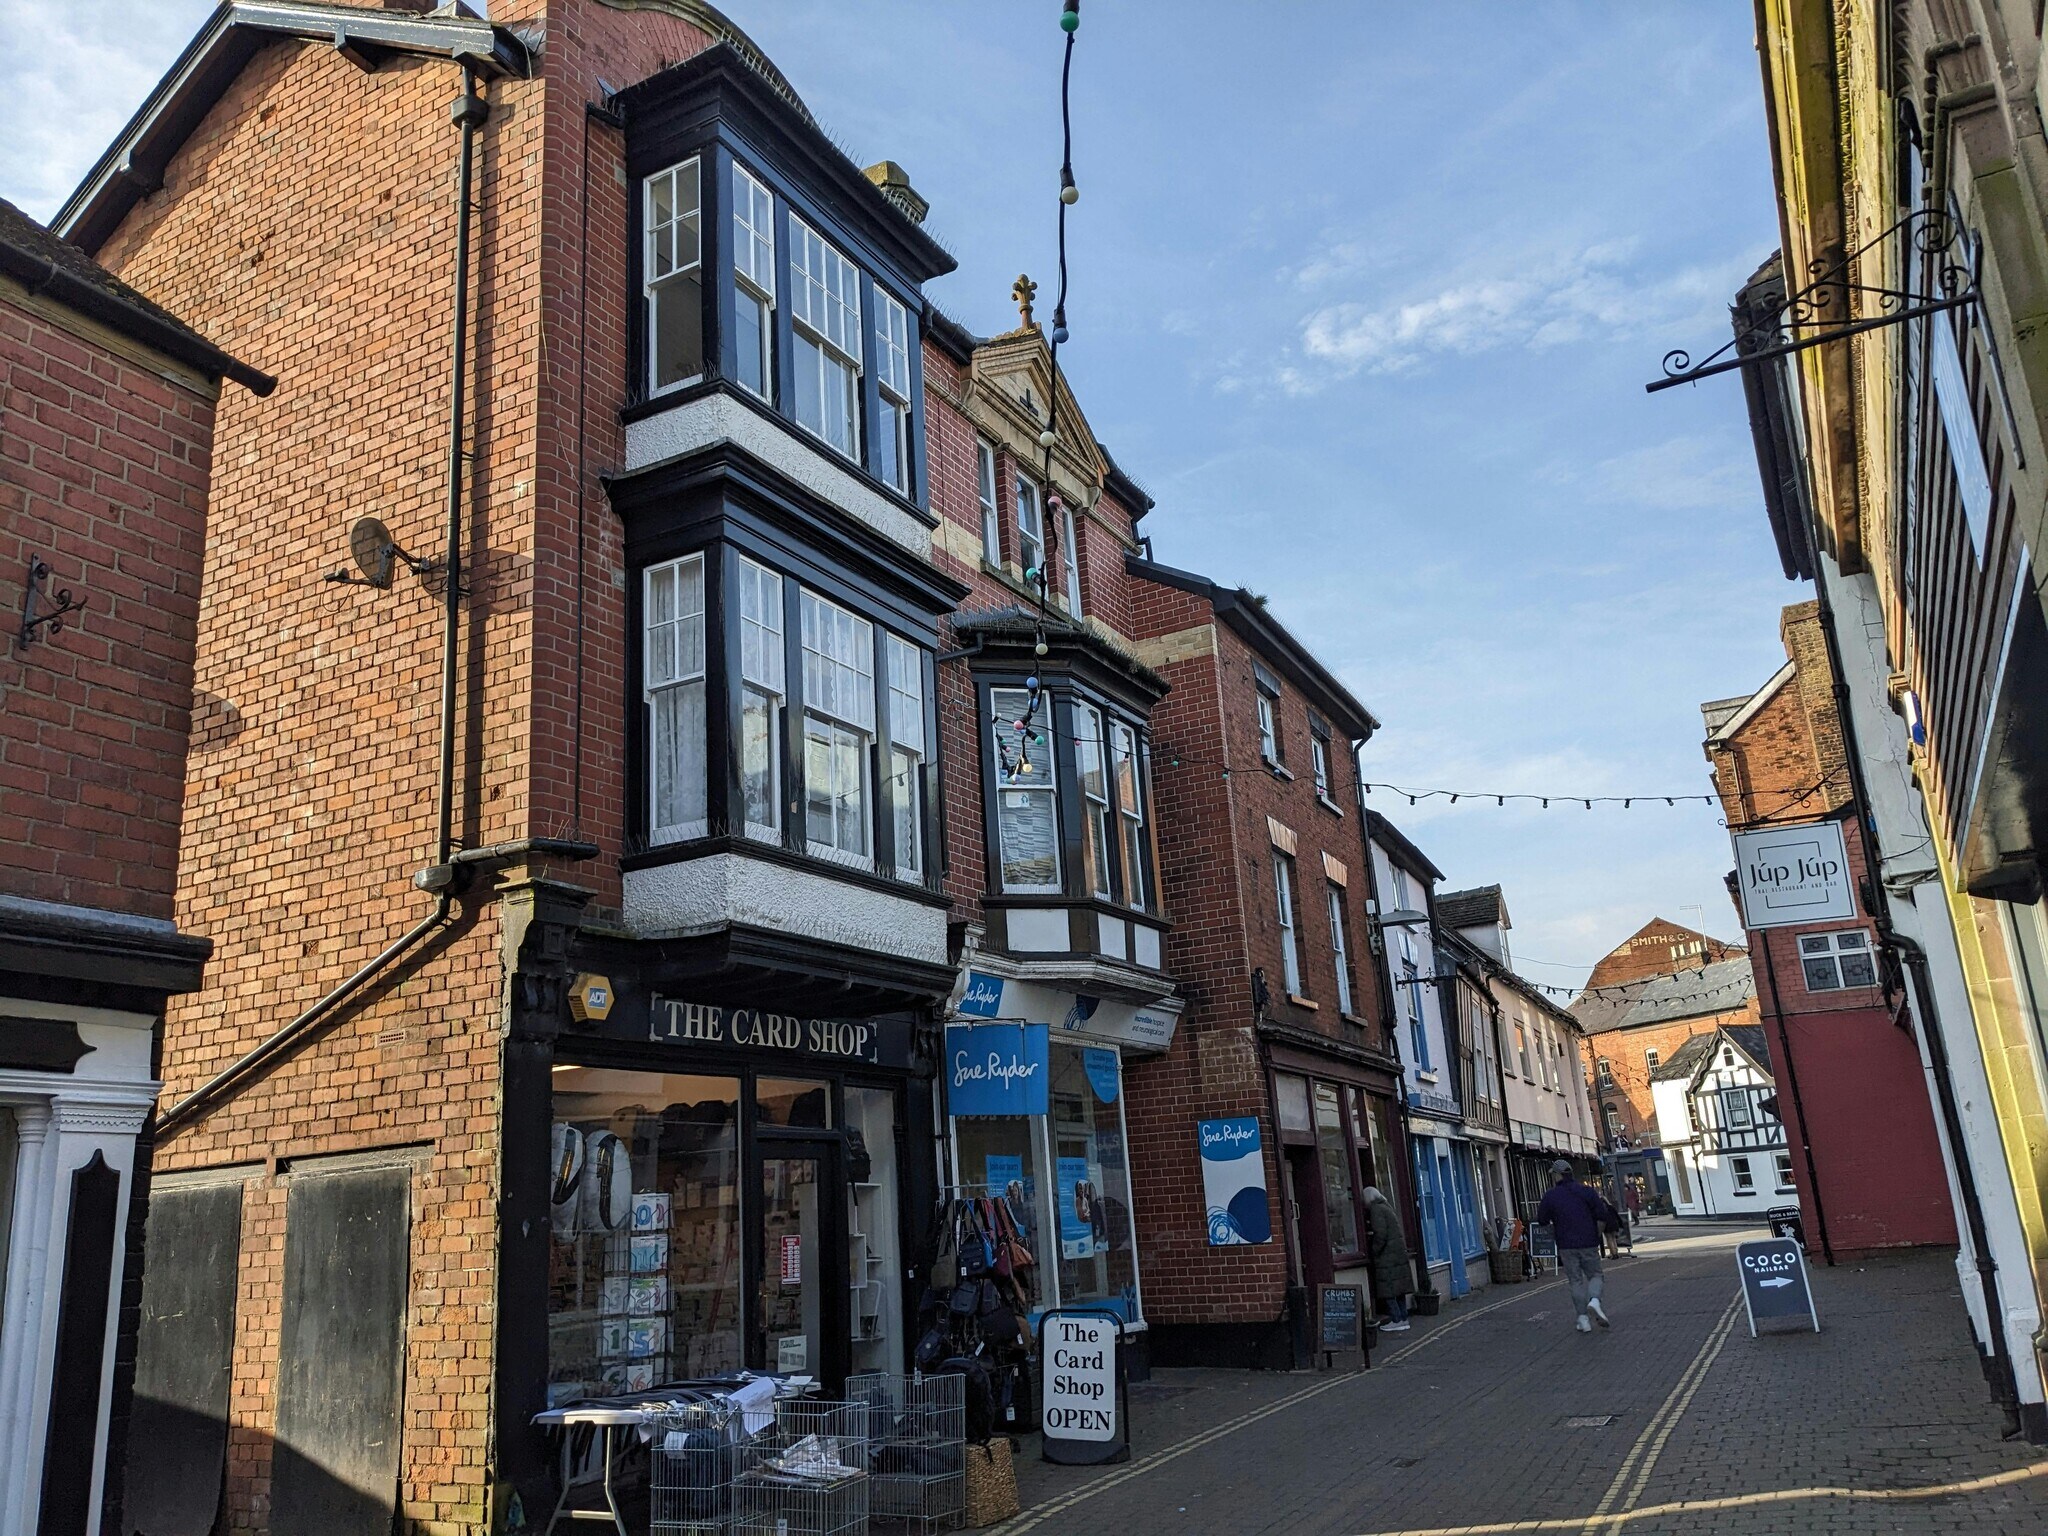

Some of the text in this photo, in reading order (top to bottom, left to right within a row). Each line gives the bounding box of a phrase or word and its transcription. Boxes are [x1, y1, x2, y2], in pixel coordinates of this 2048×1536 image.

[1750, 857, 1838, 889] Júp Júp
[1772, 884, 1807, 893] RESTAURANT
[1632, 935, 1667, 946] SMITH
[1668, 934, 1676, 943] &
[588, 991, 607, 1004] ADT
[974, 982, 999, 1012] Ryder
[664, 998, 868, 1056] THE CARD SHOP
[954, 1050, 1039, 1090] Sue Ryder
[1202, 1124, 1256, 1147] Sue Ryder
[1744, 1252, 1796, 1268] COCO
[1325, 1289, 1355, 1297] CRUMBS
[1060, 1323, 1099, 1343] The
[1054, 1349, 1104, 1370] Card
[1054, 1375, 1104, 1400] Shop
[1046, 1407, 1112, 1431] OPEN
